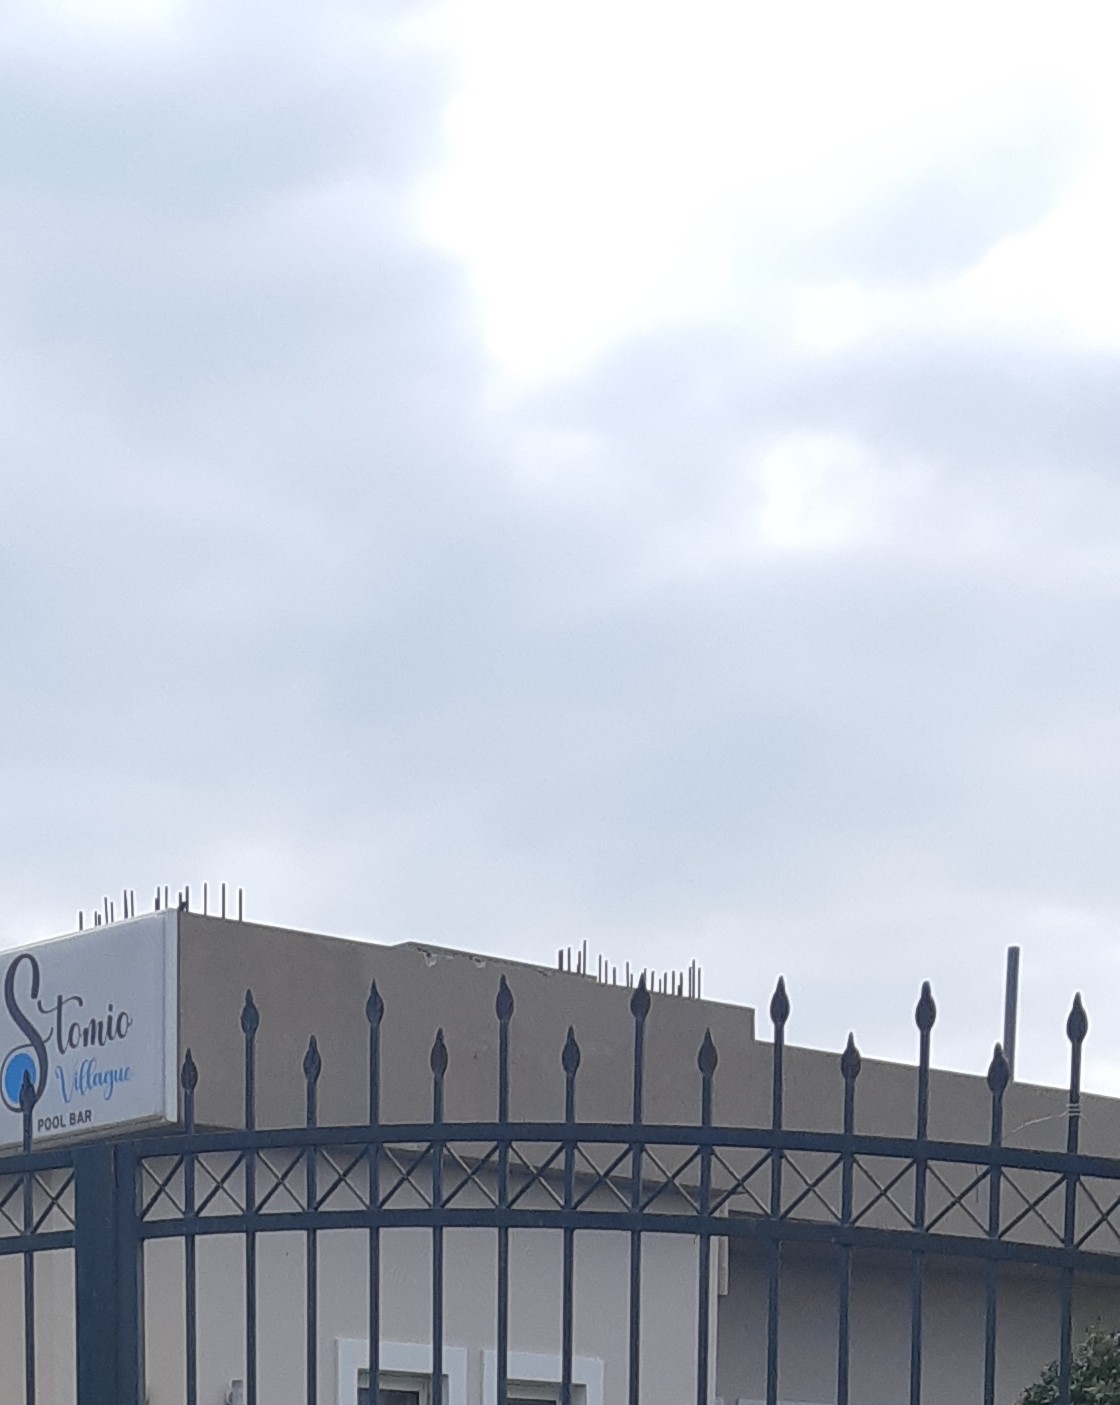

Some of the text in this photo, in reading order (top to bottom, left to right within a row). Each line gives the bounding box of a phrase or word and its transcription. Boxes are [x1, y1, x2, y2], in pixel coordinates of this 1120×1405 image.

[0, 953, 133, 1112] Stomio
[37, 1109, 92, 1132] POOL BAR
